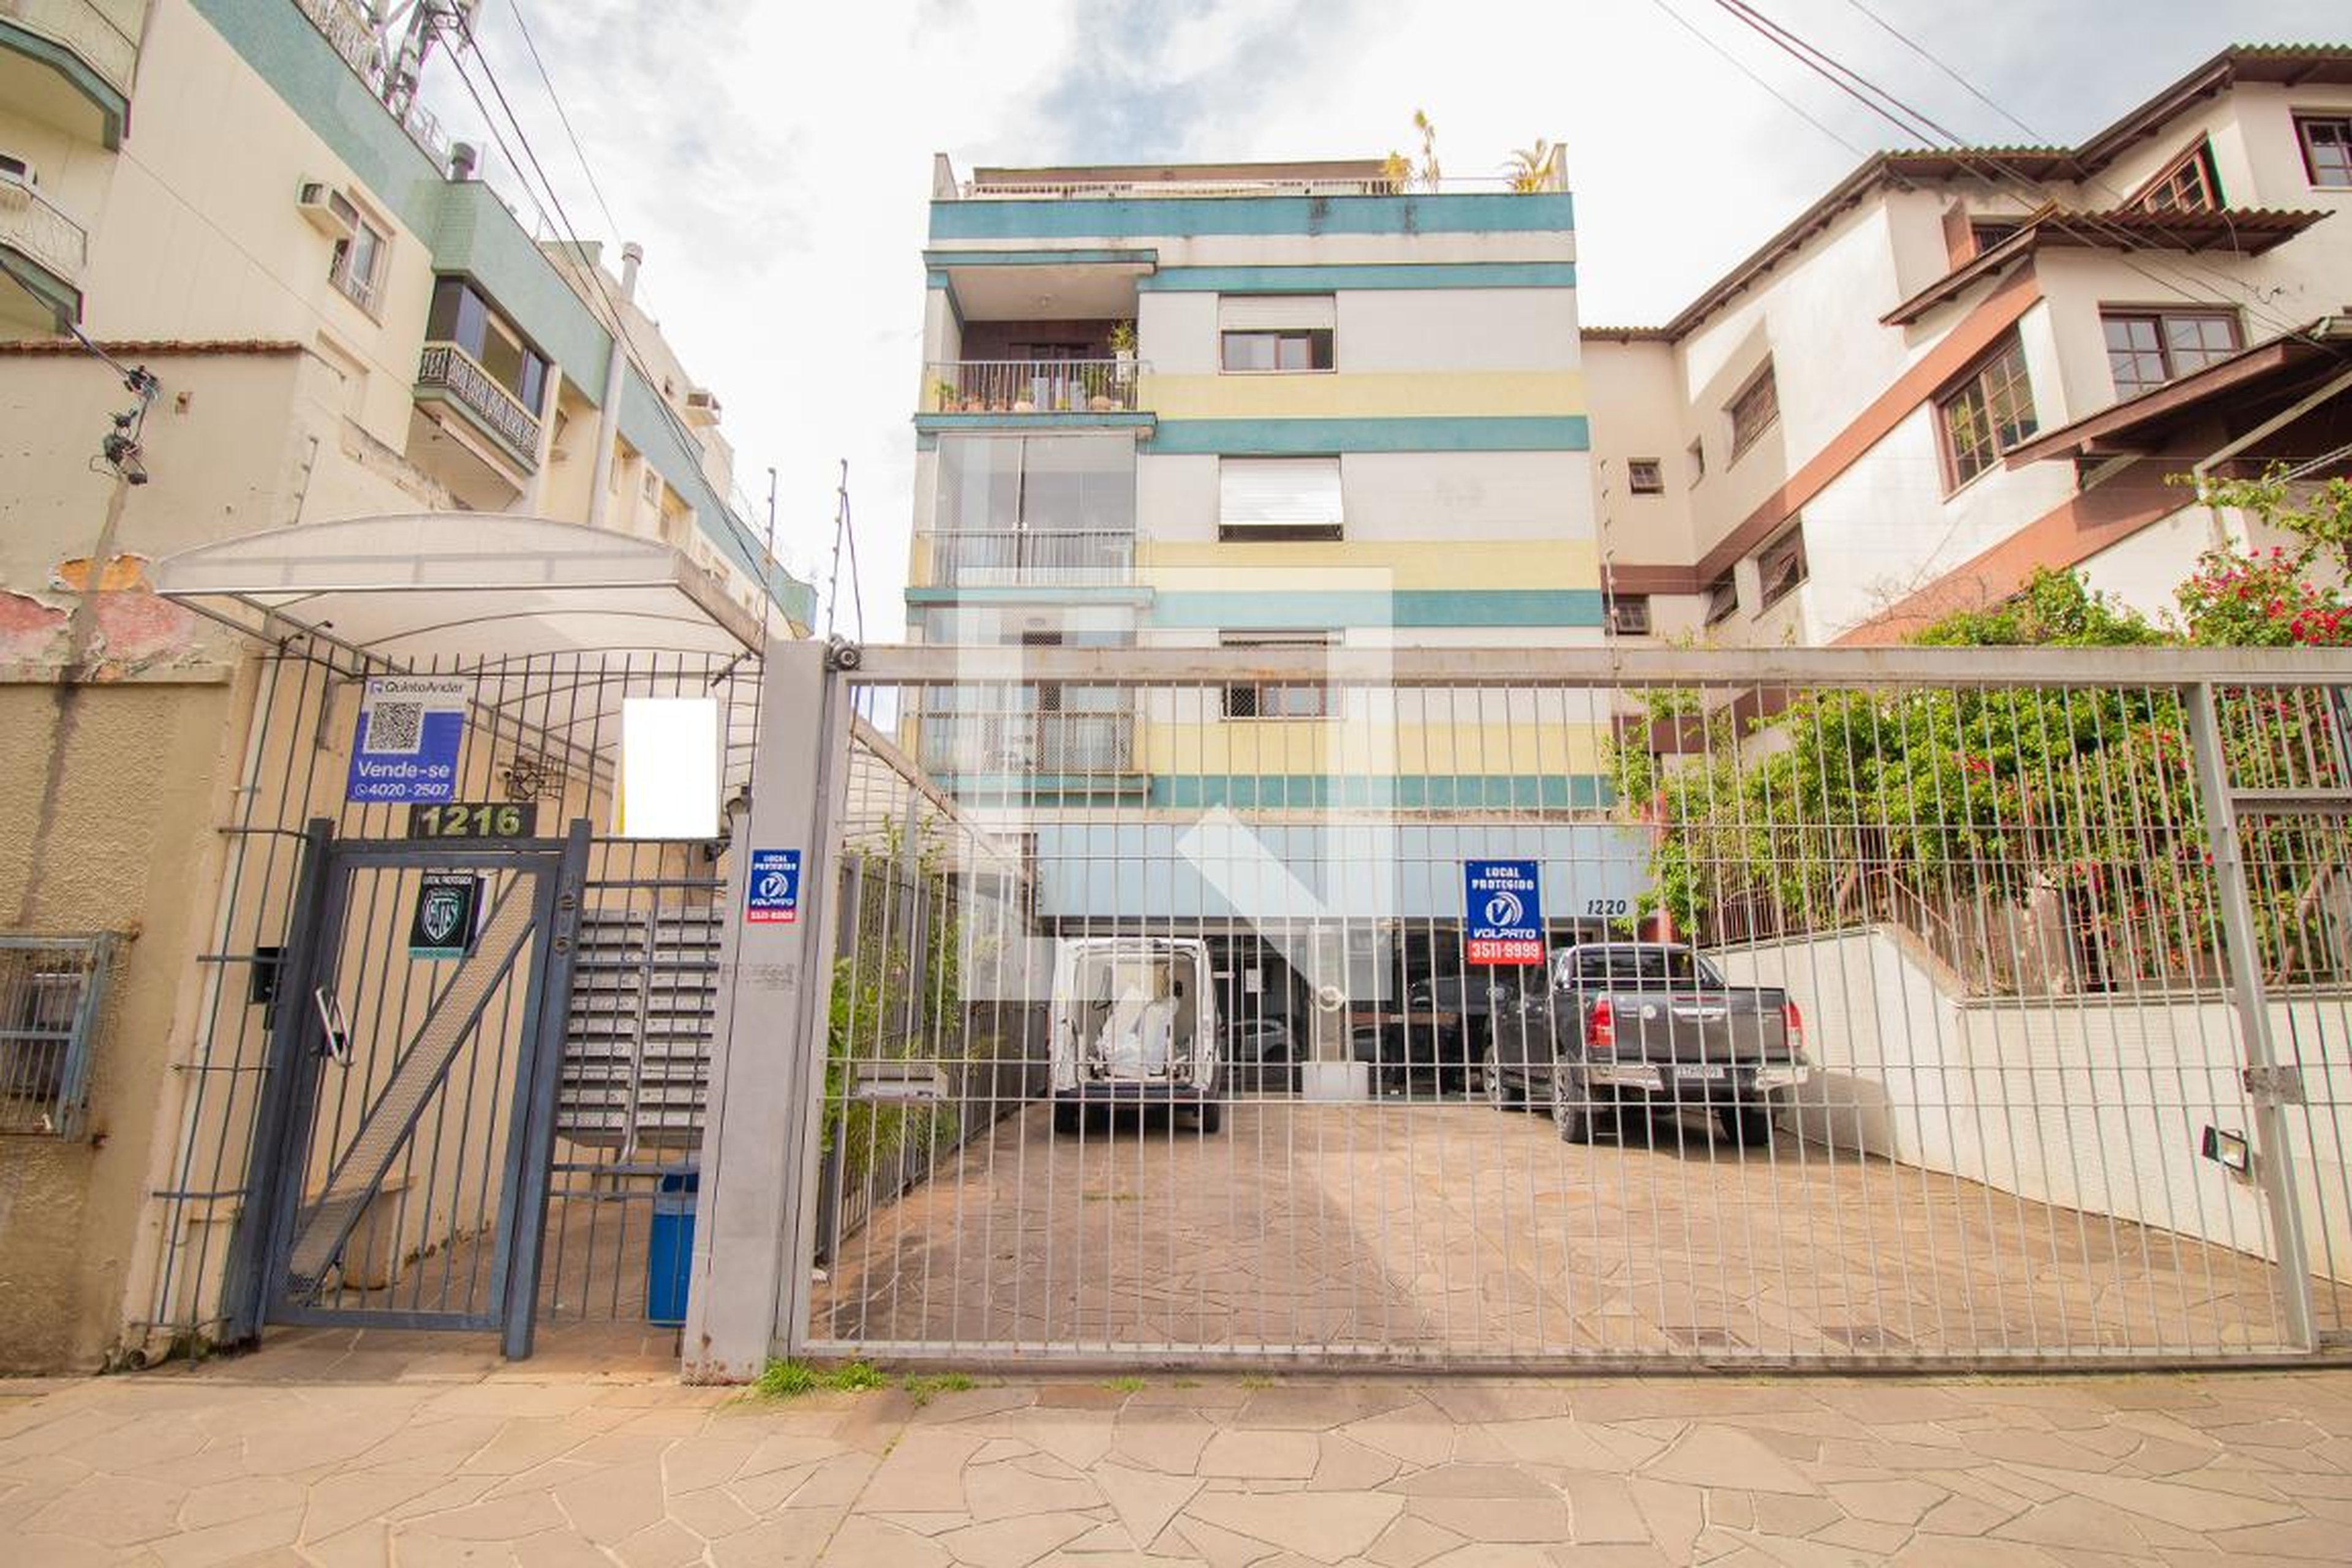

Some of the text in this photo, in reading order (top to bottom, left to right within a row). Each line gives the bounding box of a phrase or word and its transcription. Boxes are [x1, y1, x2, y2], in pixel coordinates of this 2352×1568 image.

[385, 681, 462, 693] QuintoAndar
[358, 761, 450, 778] Vende-se
[369, 783, 450, 796] 4020-2507
[422, 805, 521, 837] 1216
[1485, 867, 1521, 878] LOCAL
[1471, 879, 1535, 890] PROTEGIDO
[1587, 900, 1627, 915] 1220
[1473, 928, 1537, 940] VOLPATO
[1471, 941, 1540, 959] 3511-9999
